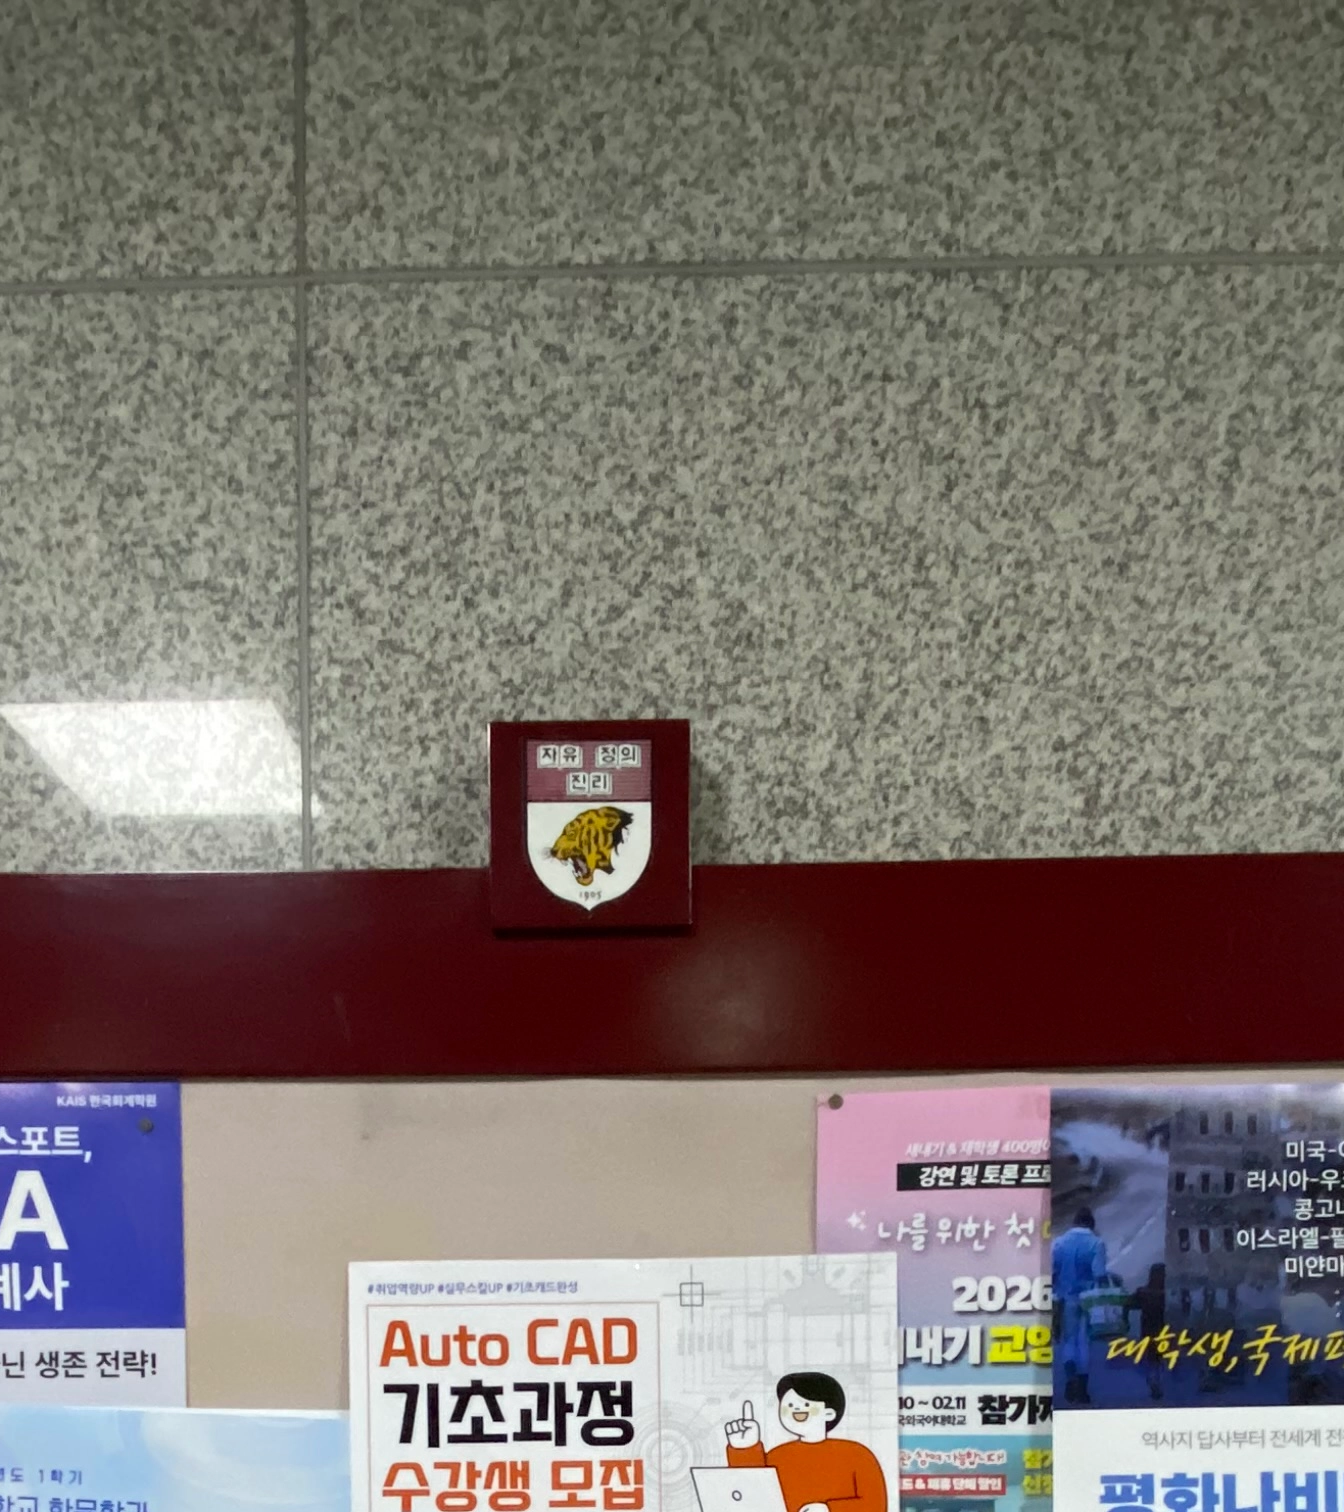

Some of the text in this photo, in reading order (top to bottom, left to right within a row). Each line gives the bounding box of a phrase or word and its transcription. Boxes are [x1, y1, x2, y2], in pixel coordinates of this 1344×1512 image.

[542, 747, 636, 763] 자유 정의
[572, 774, 607, 790] 진리
[579, 890, 602, 900] 1905
[56, 1095, 86, 1108] KAIS
[919, 1164, 1019, 1187] 강연 및 토론
[878, 1211, 1034, 1250] 나를 위한 첫
[952, 1276, 1053, 1313] 2026
[379, 1317, 638, 1366] Auto CAD
[899, 1325, 983, 1365] 내기
[35, 1352, 87, 1379] 생존
[95, 1351, 158, 1379] 전략!
[383, 1379, 635, 1448] 기초과정
[1141, 1431, 1193, 1450] 역사지
[1198, 1430, 1266, 1451] 답사부터
[1270, 1428, 1322, 1447] 전세계
[38, 1468, 83, 1486] 1학기
[382, 1459, 645, 1512] 수강생 모집
